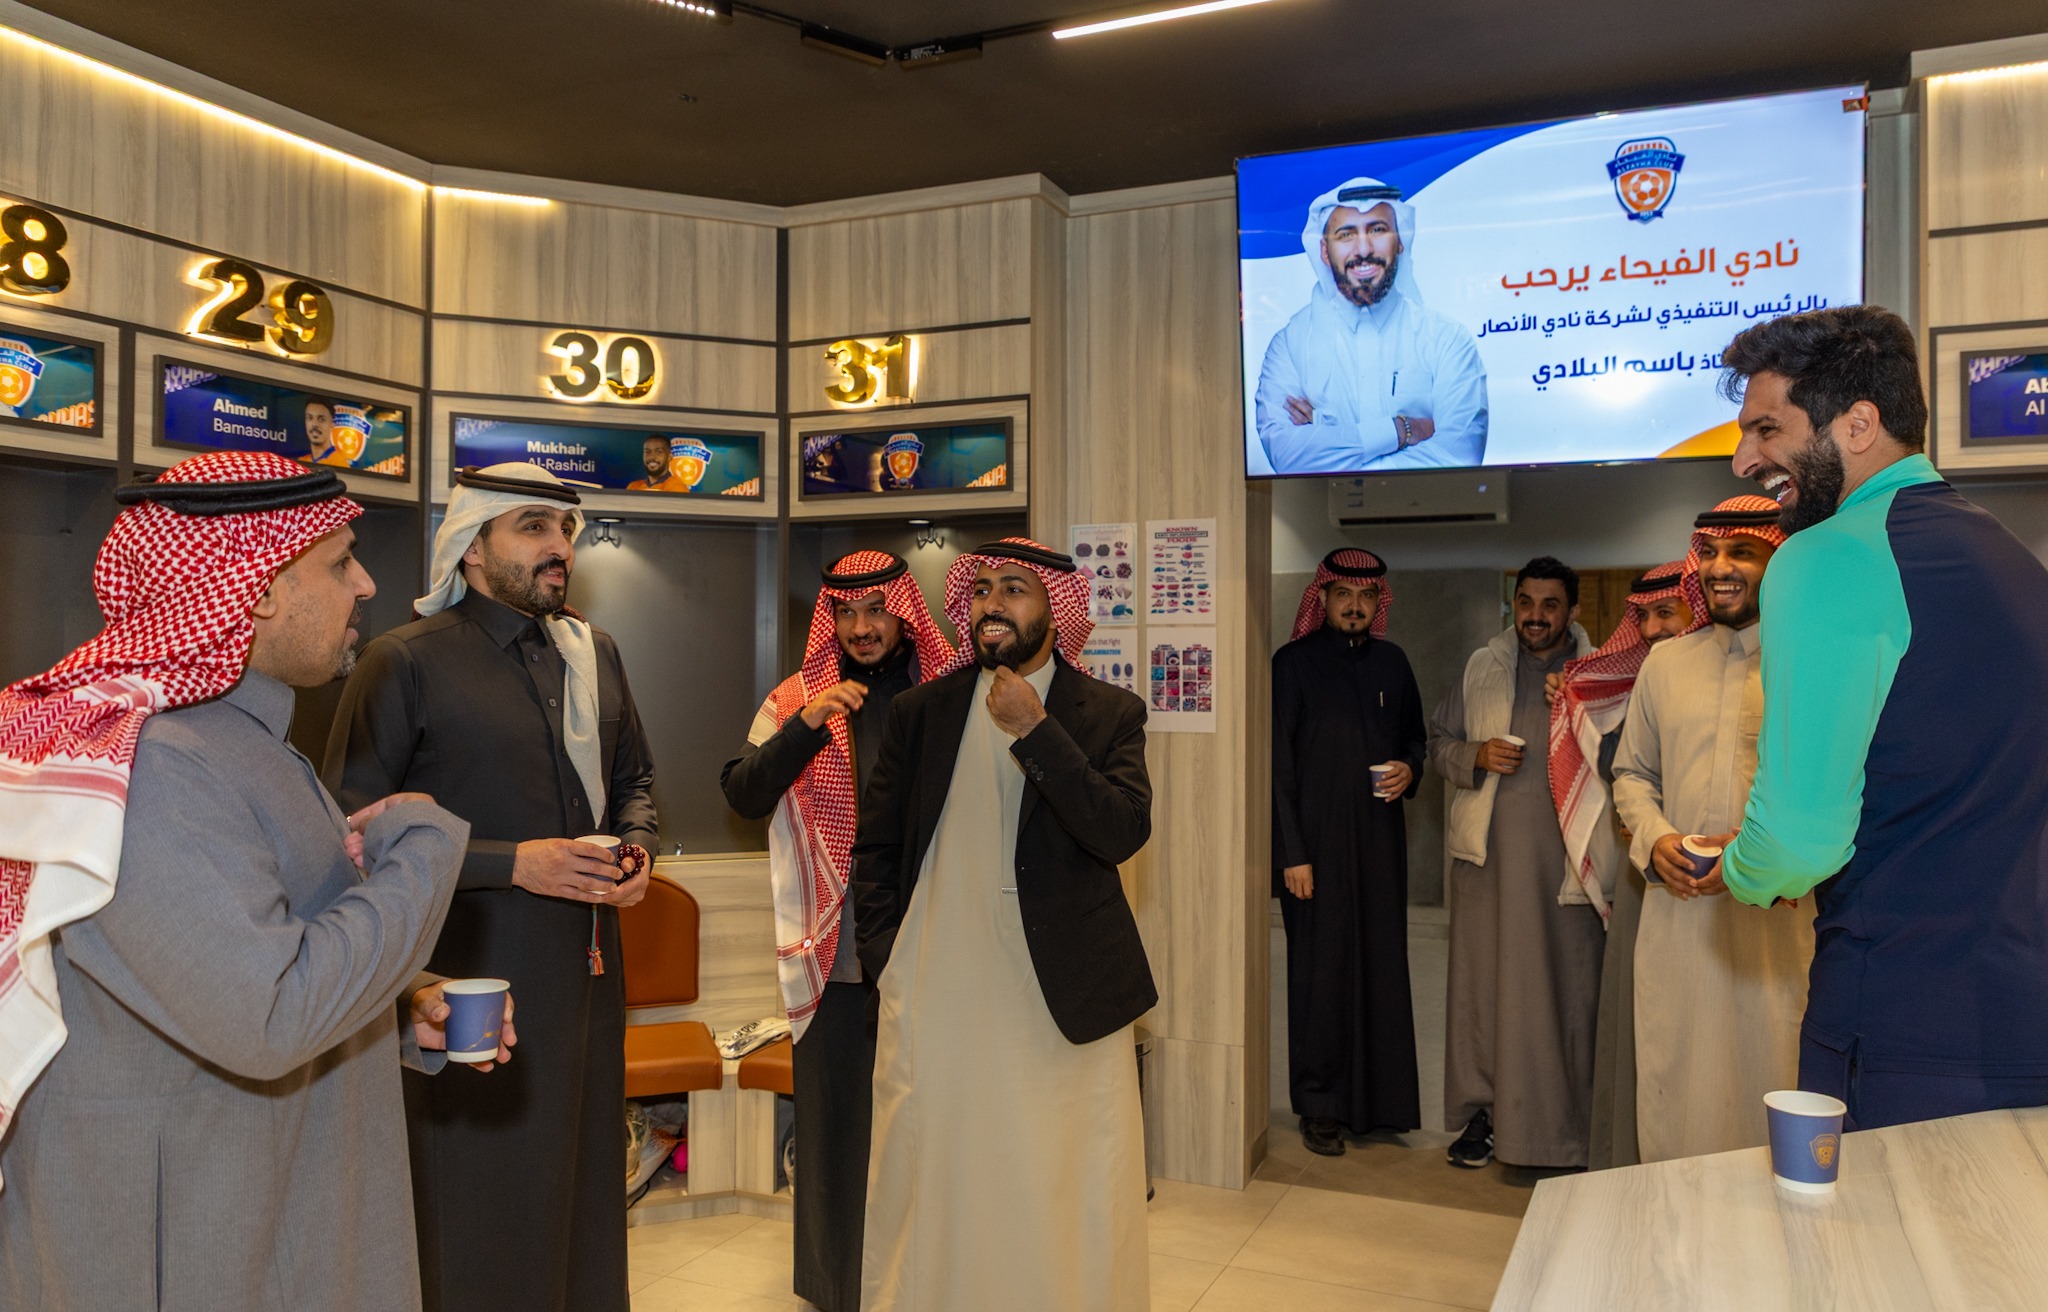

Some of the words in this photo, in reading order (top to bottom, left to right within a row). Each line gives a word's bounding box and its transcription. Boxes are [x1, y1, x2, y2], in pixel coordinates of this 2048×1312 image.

[1599, 247, 1716, 285] الفيحاء
[1725, 238, 1799, 286] نادي
[1501, 264, 1590, 297] يرحب
[198, 259, 335, 355] 29
[1584, 304, 1652, 328] لشركة
[1656, 300, 1738, 330] التنفيذي
[1477, 313, 1537, 338] الأنصار
[1541, 311, 1581, 338] نادي
[549, 332, 655, 400] 30
[824, 335, 911, 404] 31
[1532, 355, 1617, 391] البلادي
[1624, 351, 1694, 376] باسم
[213, 397, 268, 420] Ahmed
[213, 417, 287, 442] Bamasoud
[527, 440, 587, 456] Mukhair
[528, 457, 596, 473] Al-Rashidi
